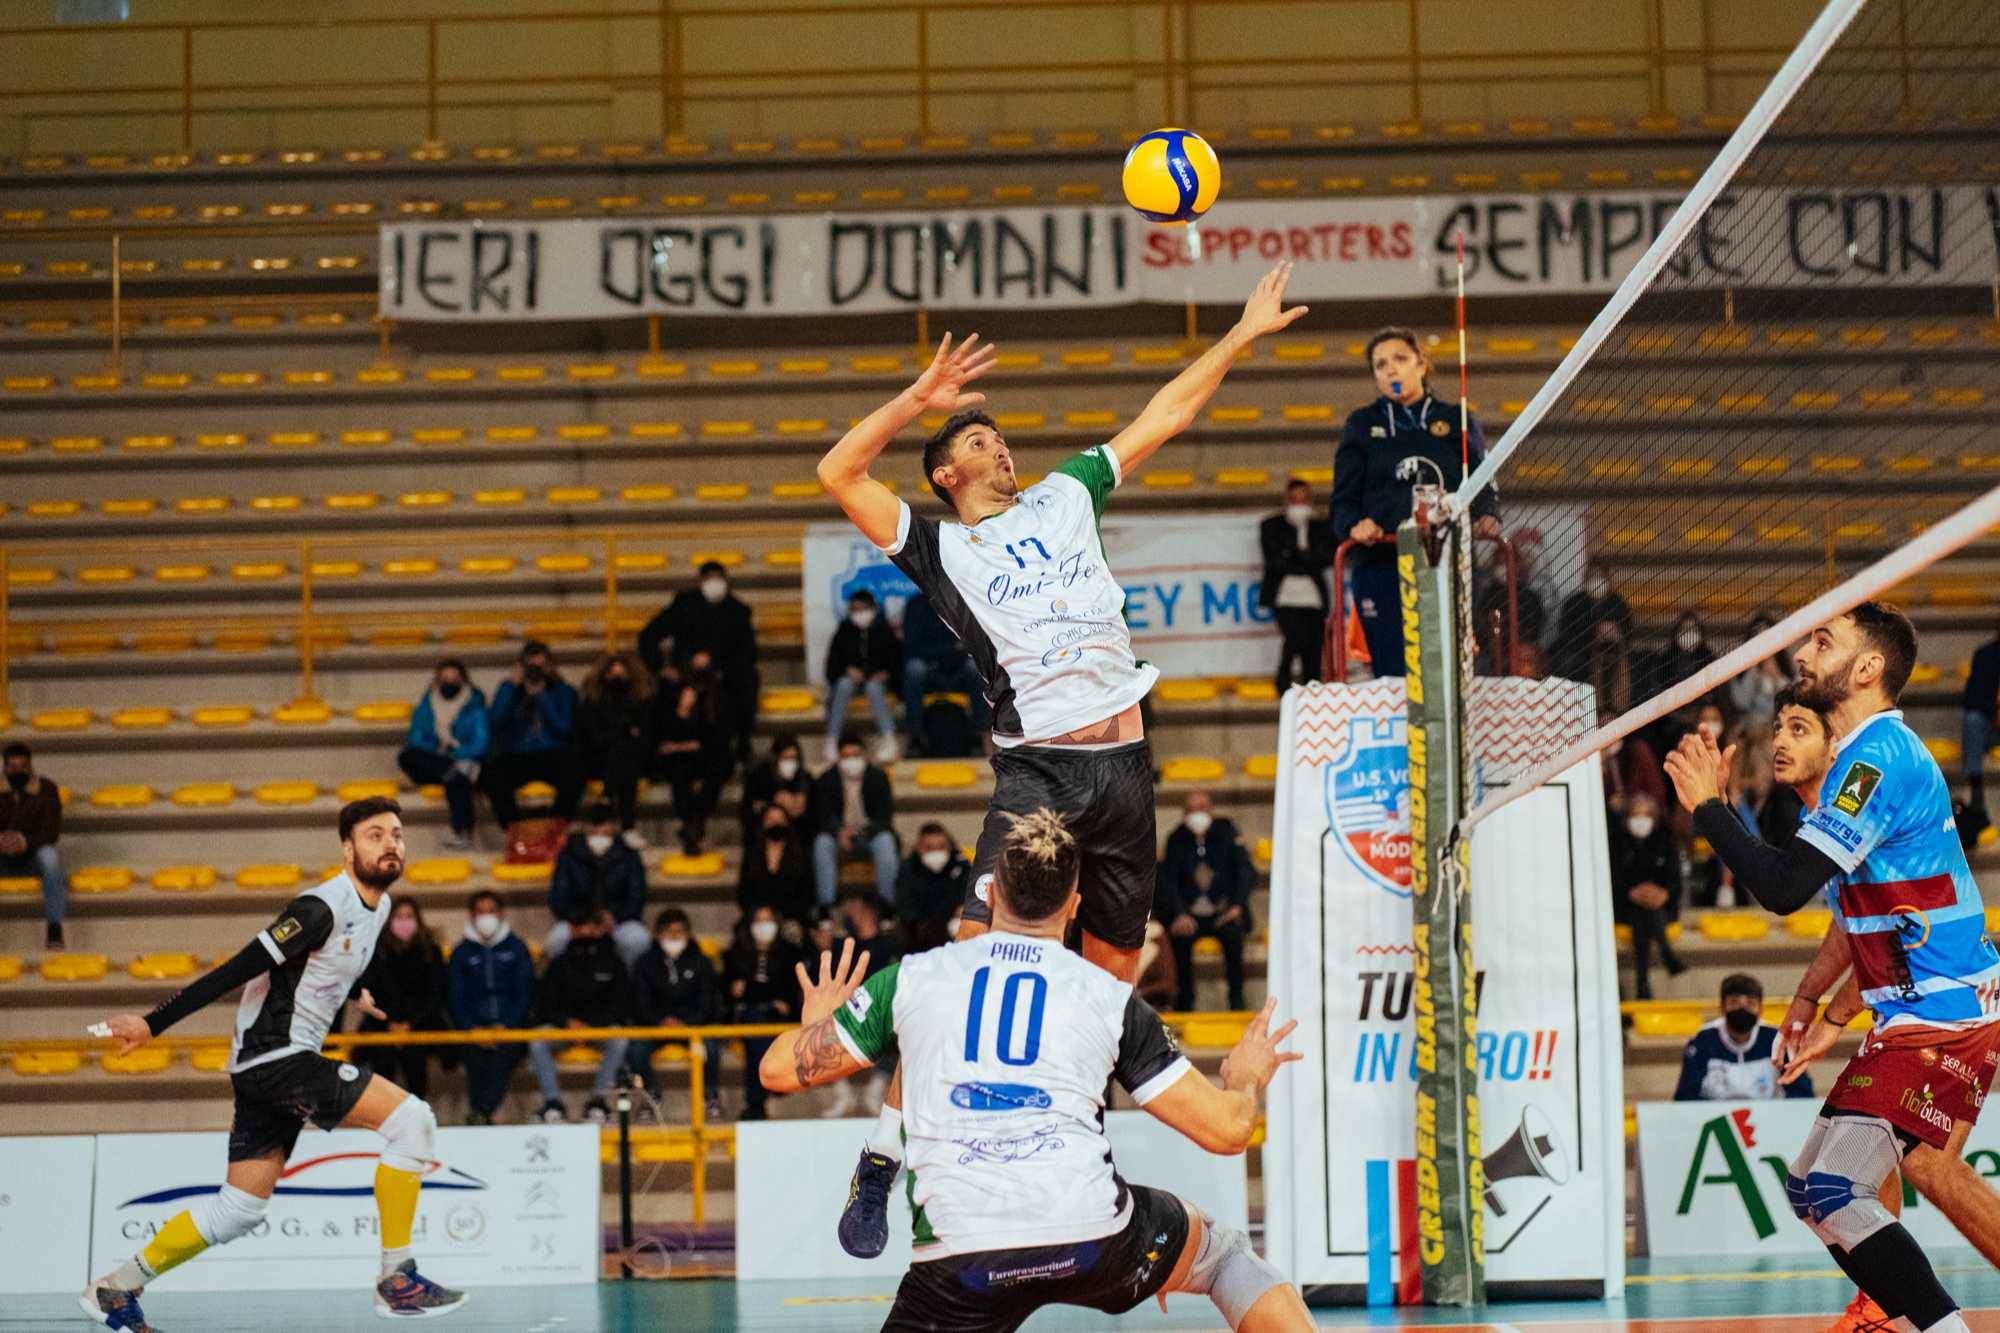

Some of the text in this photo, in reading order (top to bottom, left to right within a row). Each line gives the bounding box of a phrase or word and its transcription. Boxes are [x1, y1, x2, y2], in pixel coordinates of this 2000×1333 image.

[1142, 222, 1413, 270] SUPPORTERS
[1789, 190, 1942, 276] CON
[396, 211, 1127, 311] IERI OGGI DOMANI
[1005, 537, 1052, 569] 17
[1398, 553, 1429, 896] CREDEM BANCA
[1352, 769, 1385, 788] U.S.
[990, 942, 1043, 963] PARIS
[964, 966, 1048, 1066] 10
[1354, 1032, 1401, 1083] IN
[1412, 923, 1445, 1266] CREDEM BANCA
[281, 1218, 309, 1237] G.
[353, 1216, 428, 1236] FII
